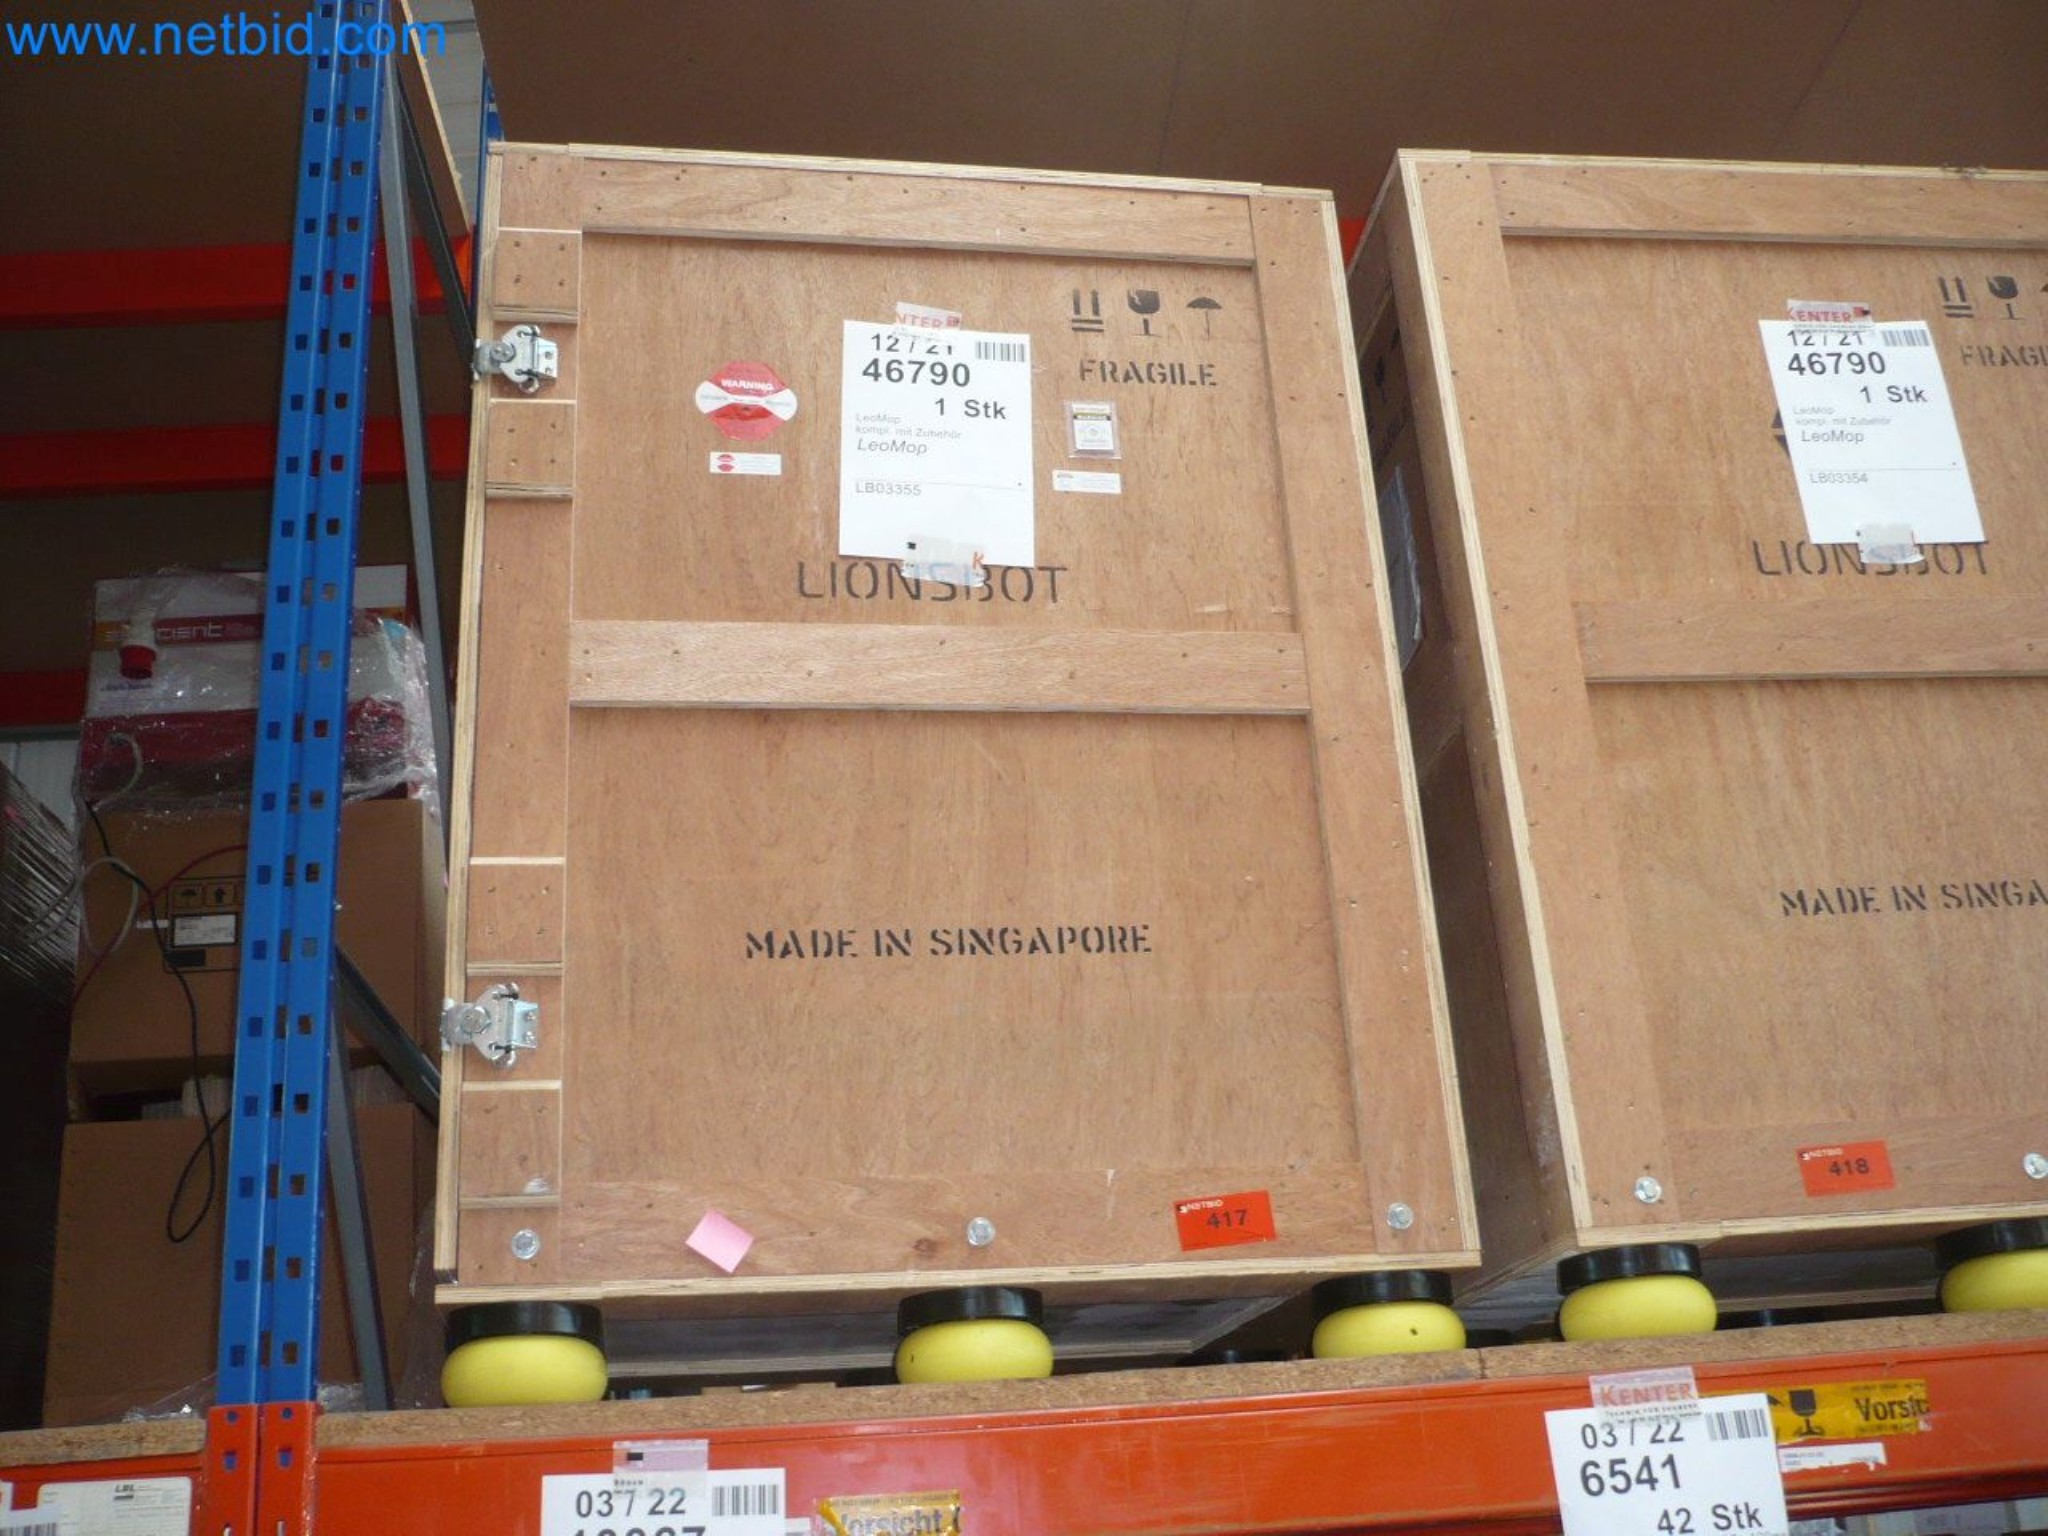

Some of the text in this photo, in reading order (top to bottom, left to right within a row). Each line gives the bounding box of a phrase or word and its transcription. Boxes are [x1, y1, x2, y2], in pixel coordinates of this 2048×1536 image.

[871, 334, 899, 352] 12
[1787, 329, 1815, 346] 12
[862, 357, 970, 387] 46790
[1079, 358, 1217, 386] FRAGILE
[1788, 351, 1886, 376] 46790
[720, 379, 773, 391] WARNING
[1860, 385, 1928, 403] 1 Stk
[935, 398, 1006, 420] 1 Stk
[857, 437, 928, 456] LeoMop
[1801, 430, 1865, 444] LeoMop
[855, 481, 922, 496] LB03355
[1779, 887, 1882, 917] MADE
[1891, 884, 1927, 911] IN
[745, 924, 1153, 959] MADE IN SINGAPORE
[1829, 1158, 1869, 1176] 418
[1206, 1209, 1247, 1228] 417
[1599, 1382, 1693, 1406] KENTER
[1581, 1422, 1617, 1449] 03
[1580, 1454, 1681, 1497] 6541
[575, 1491, 613, 1518] 03
[648, 1487, 687, 1516] 22
[1657, 1501, 1763, 1535] 42 Stk
